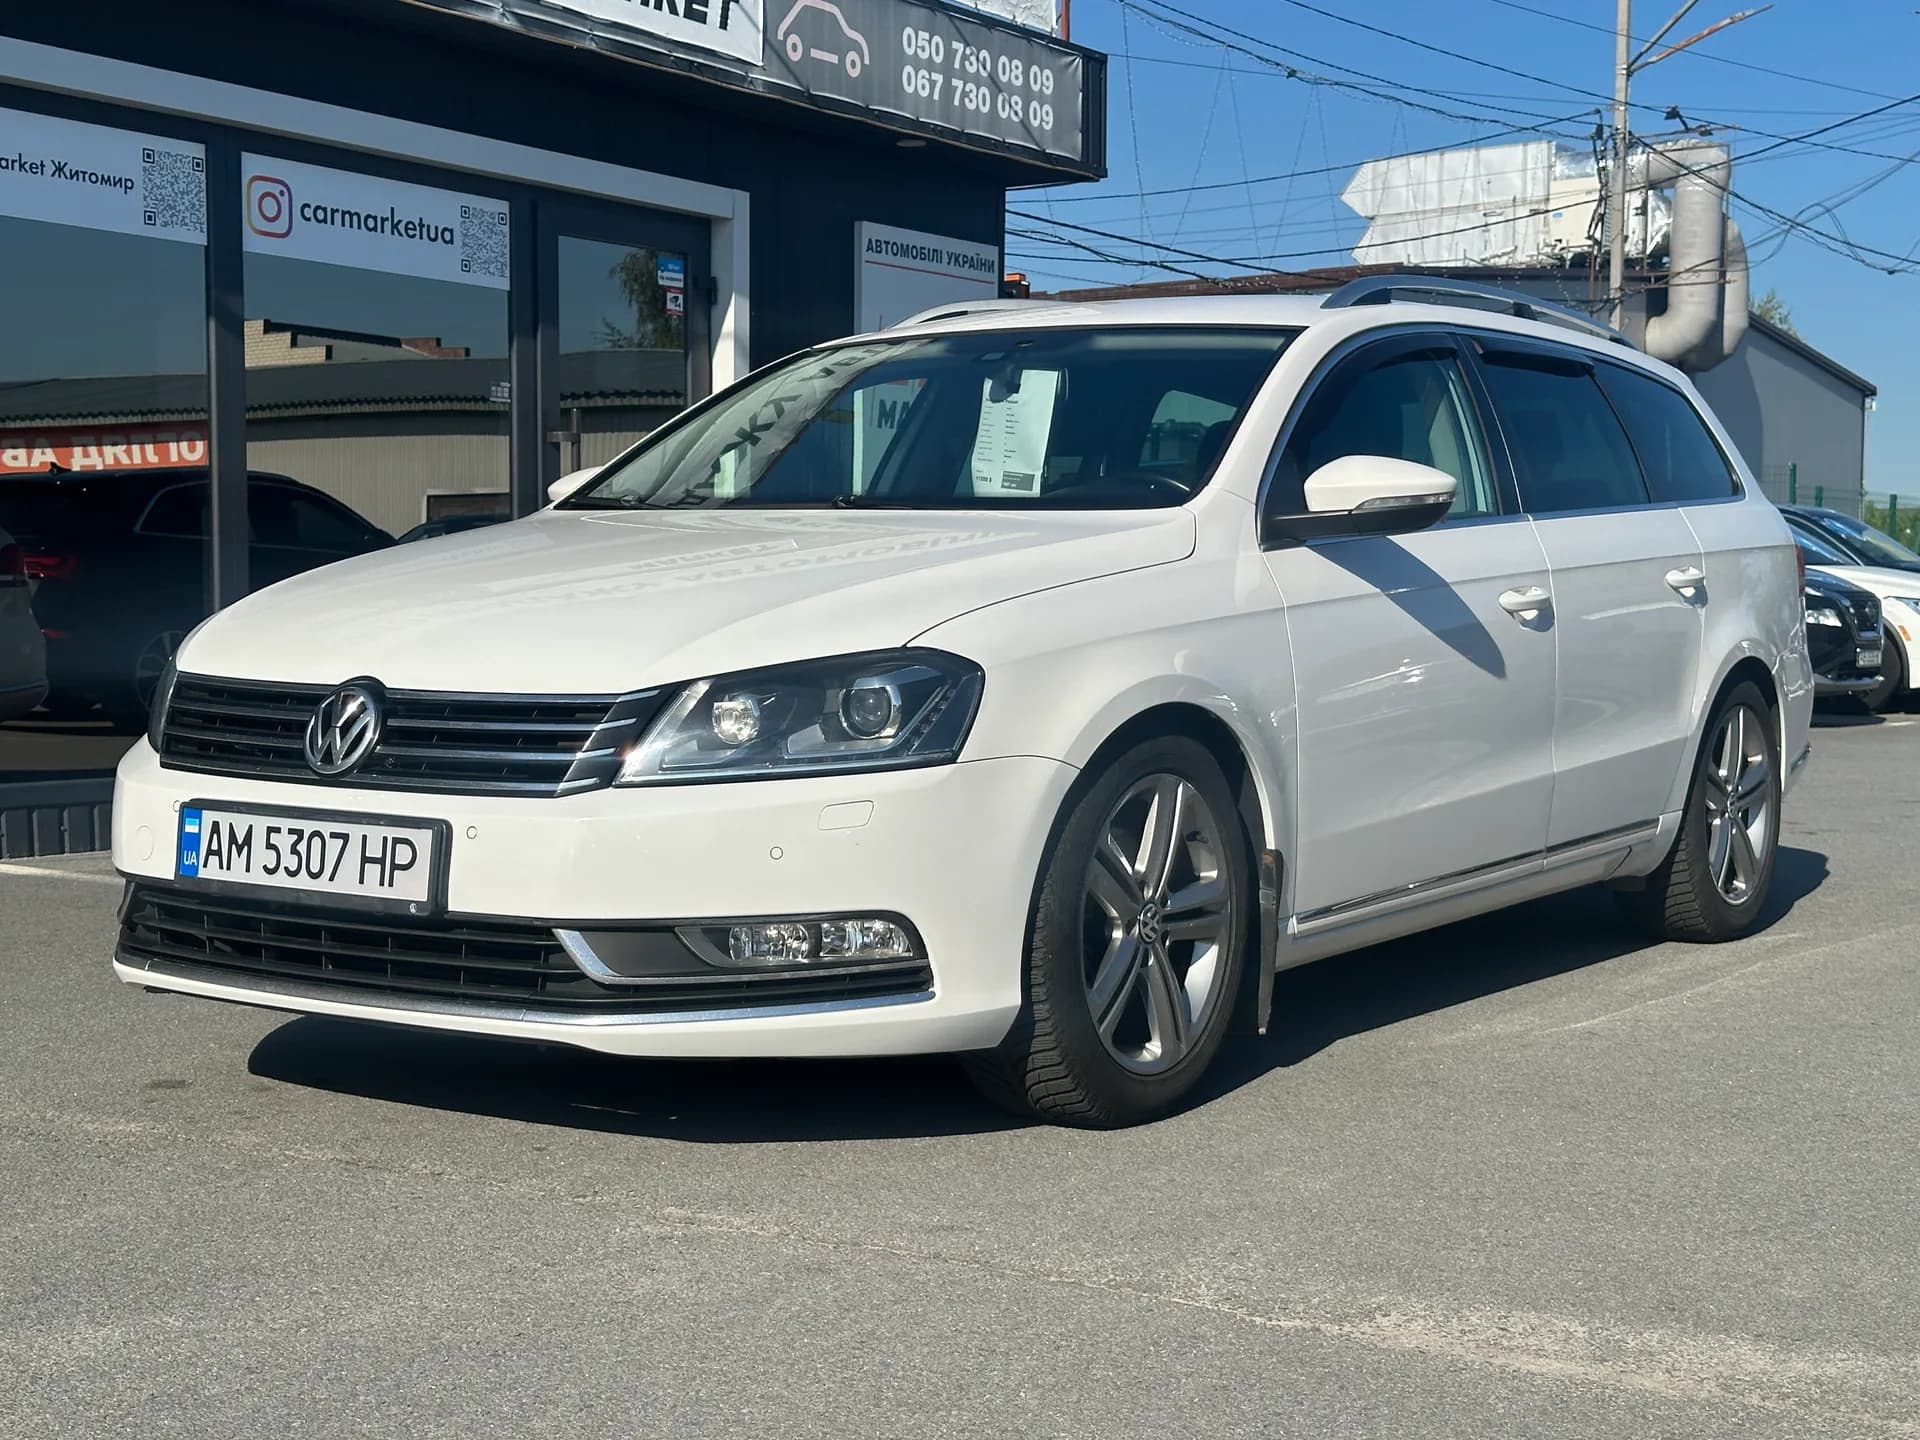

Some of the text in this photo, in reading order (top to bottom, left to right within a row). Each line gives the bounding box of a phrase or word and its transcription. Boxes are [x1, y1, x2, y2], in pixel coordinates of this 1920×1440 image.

[902, 26, 1054, 95] 050 730 08 09
[902, 65, 1054, 131] 067 730 08 09
[50, 159, 135, 195] Житомир
[300, 202, 455, 246] carmarketua
[865, 238, 996, 274] АВТОМОБІЛІ УКРАЇНИ
[183, 850, 198, 867] UA
[202, 819, 418, 888] AM 5307 HP
